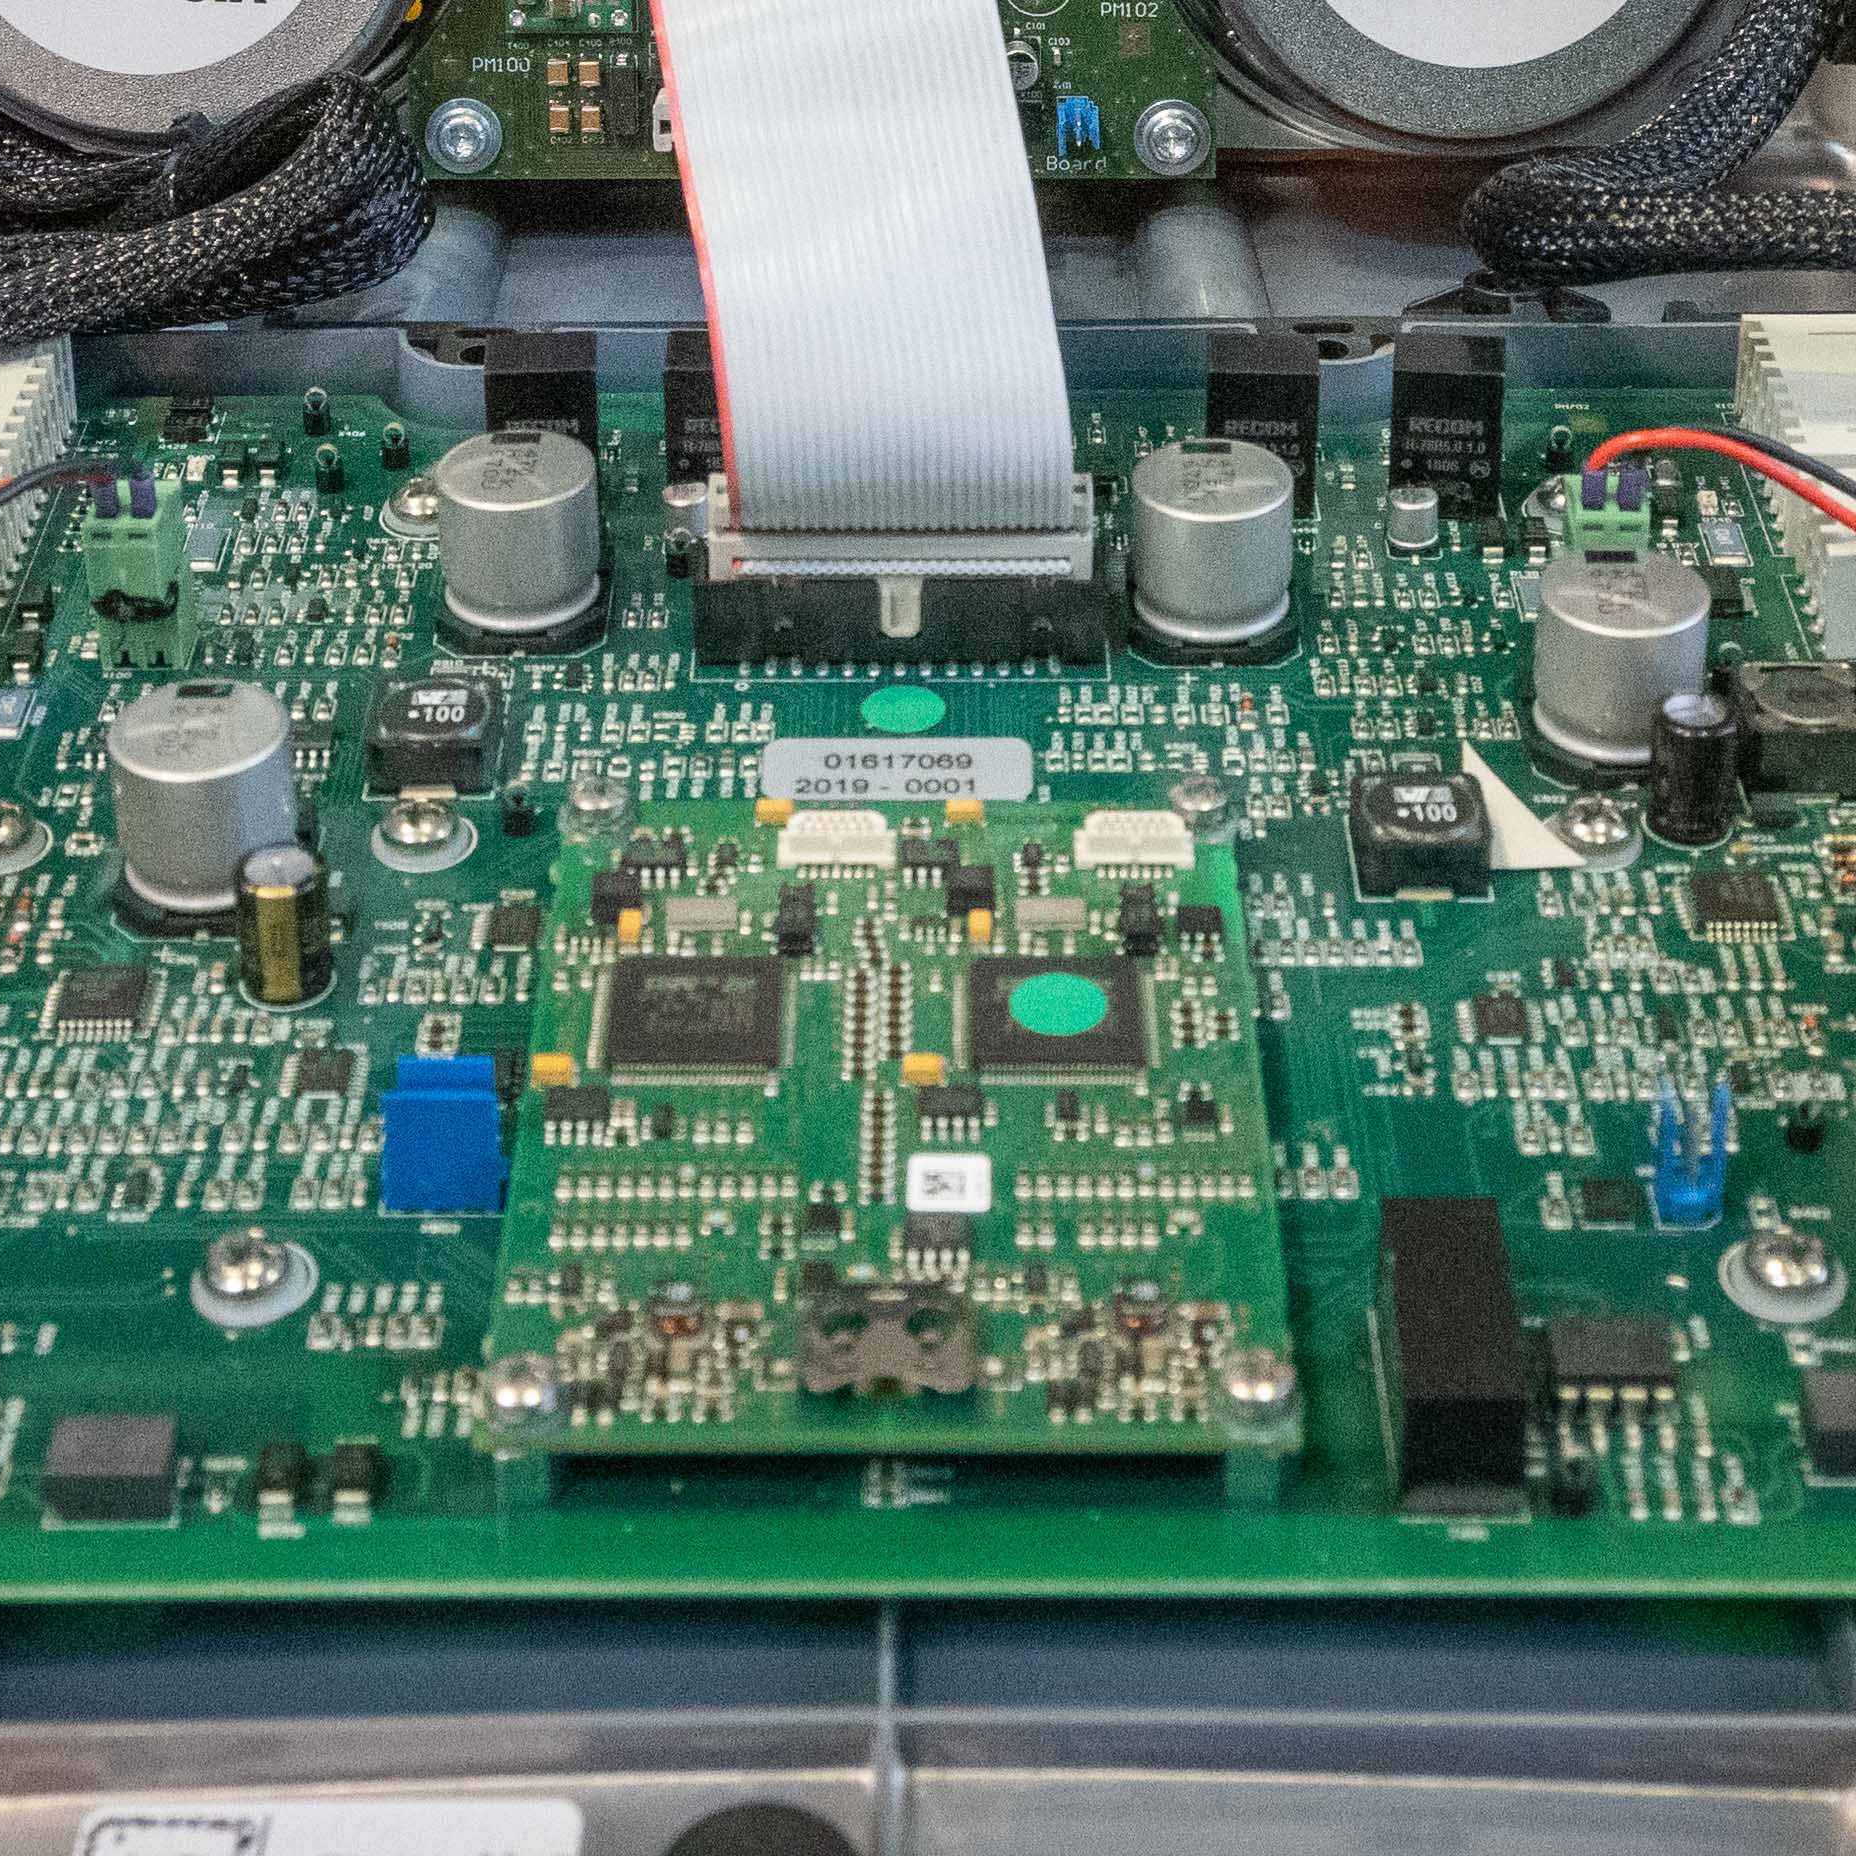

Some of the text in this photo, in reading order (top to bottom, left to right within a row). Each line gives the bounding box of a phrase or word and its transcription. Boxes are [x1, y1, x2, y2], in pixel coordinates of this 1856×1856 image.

[1101, 2, 1159, 18] PM102
[472, 56, 532, 73] PM100
[1046, 155, 1107, 171] Board
[824, 752, 974, 771] 01617069
[795, 776, 870, 795] 2019
[904, 776, 976, 796] 0001
